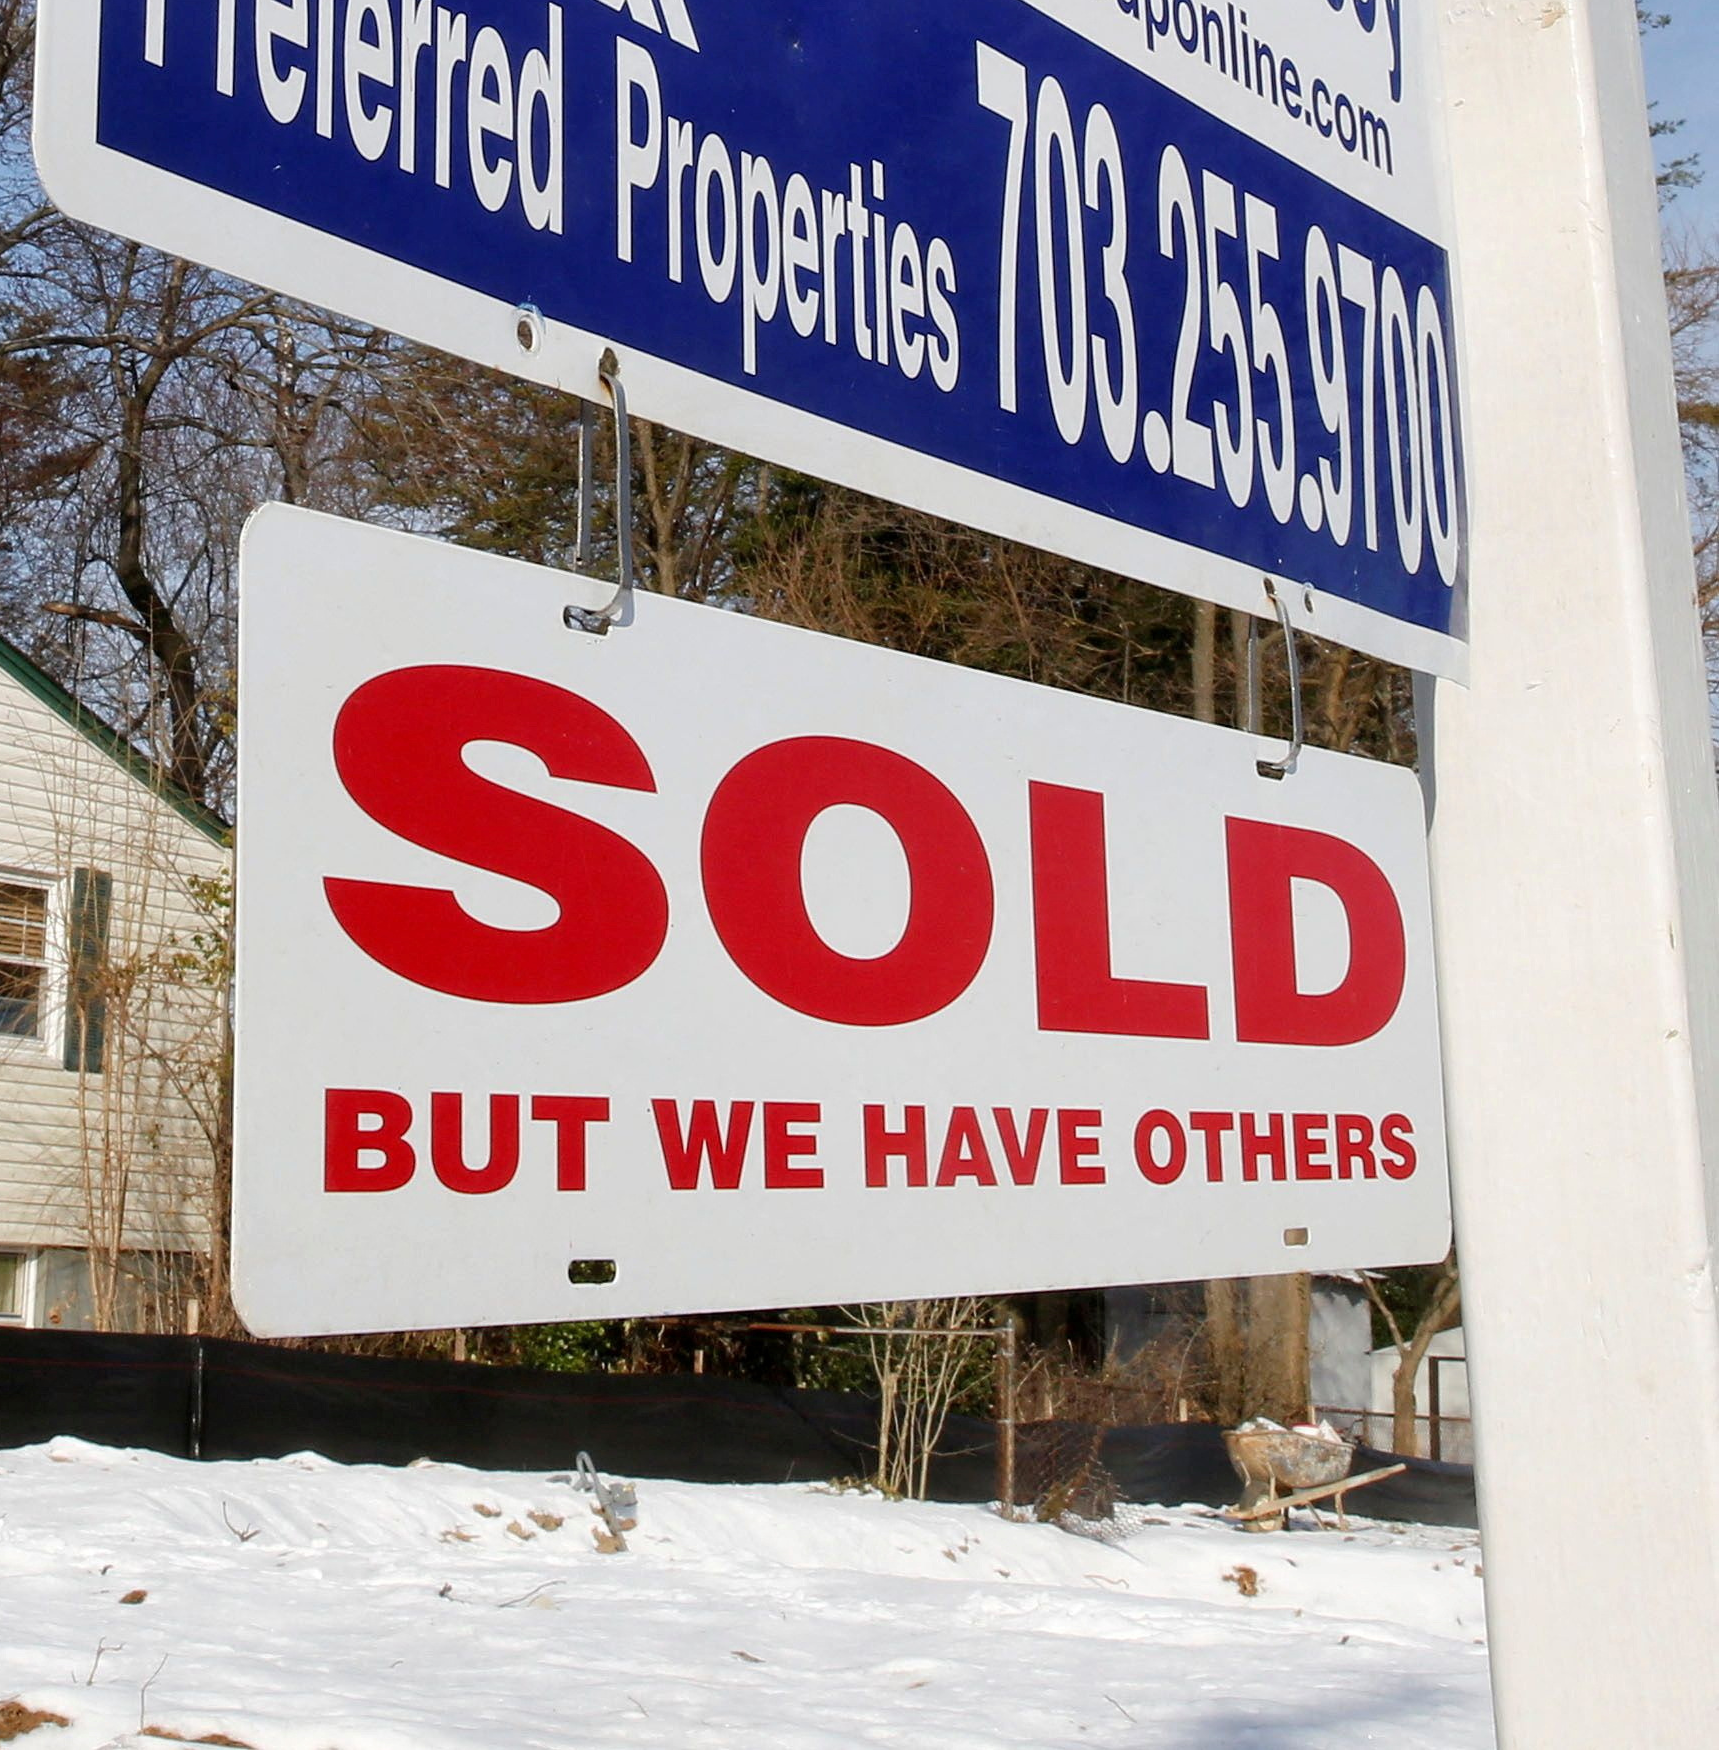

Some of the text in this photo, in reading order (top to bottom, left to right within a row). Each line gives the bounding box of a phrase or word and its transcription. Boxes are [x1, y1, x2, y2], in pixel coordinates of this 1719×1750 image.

[616, 35, 960, 393] Properties
[975, 40, 1460, 588] 703.255.9700
[322, 663, 1407, 1047] SOLD
[323, 1087, 1418, 1193] BUT WE HAVE OTHERS
